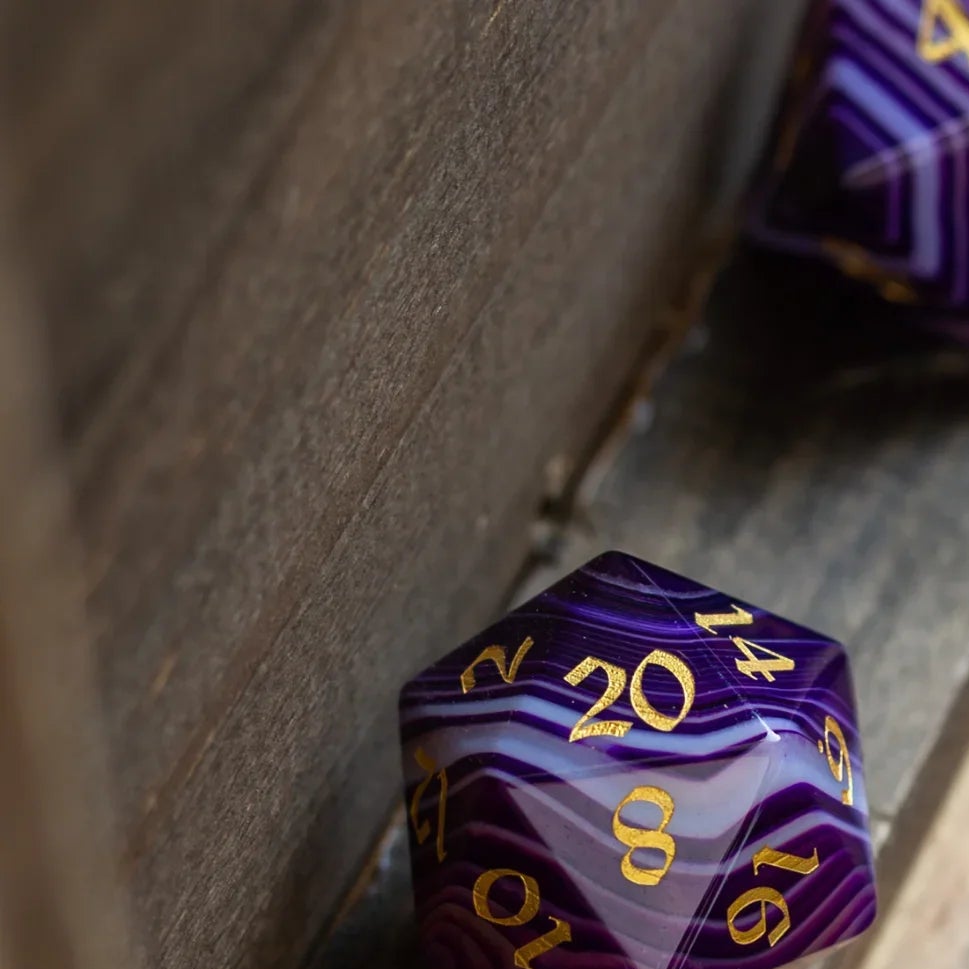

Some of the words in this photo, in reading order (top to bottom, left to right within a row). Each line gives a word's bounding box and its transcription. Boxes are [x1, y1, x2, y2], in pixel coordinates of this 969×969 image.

[459, 636, 534, 694] 2
[694, 604, 796, 683] 14
[564, 649, 696, 742] 20
[612, 785, 677, 886] 8
[726, 845, 820, 947] 16
